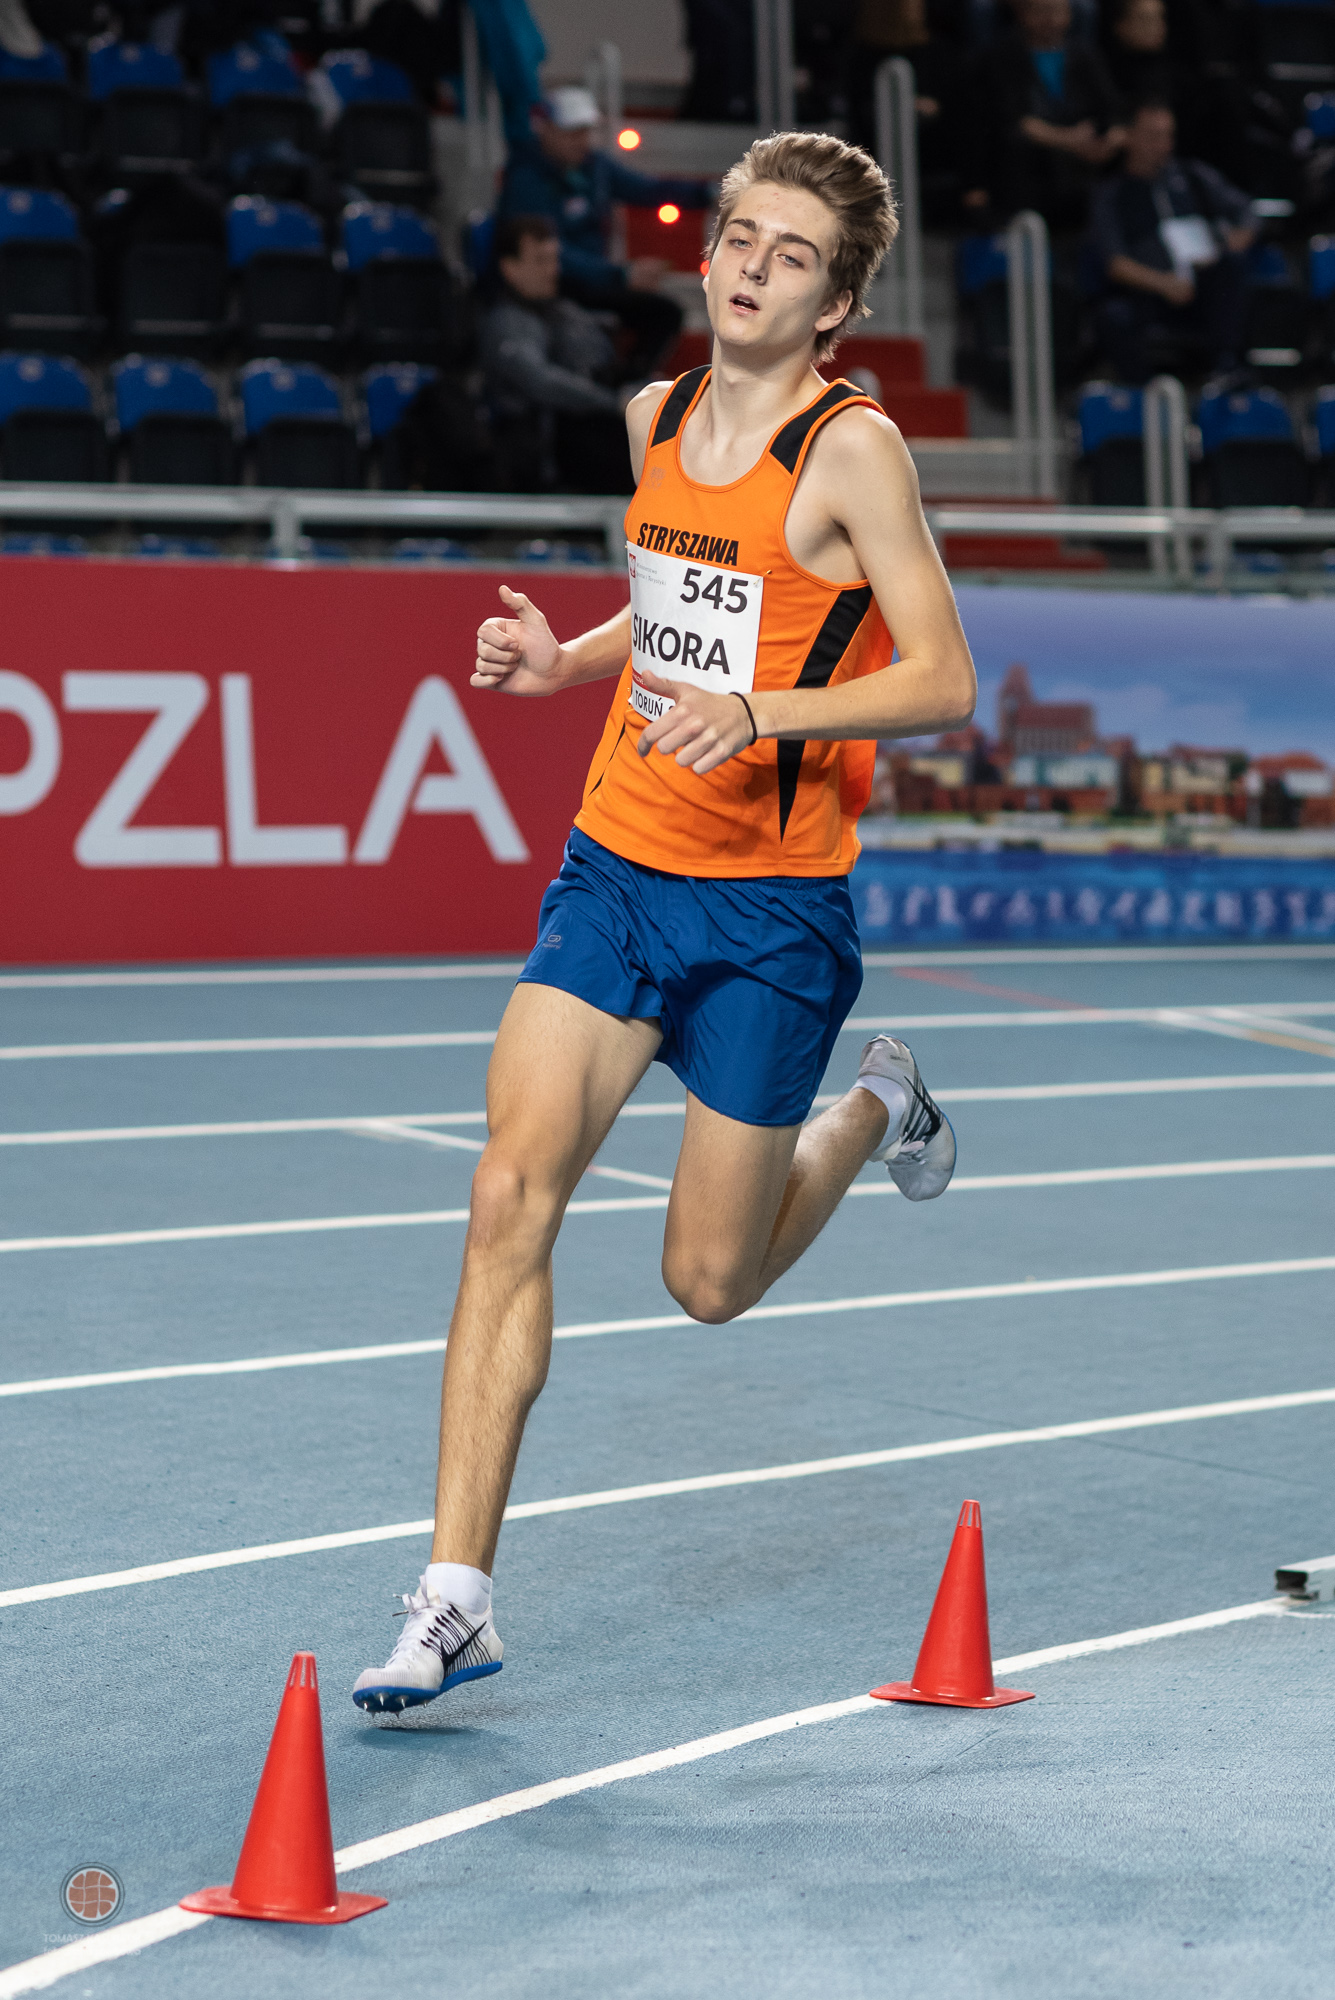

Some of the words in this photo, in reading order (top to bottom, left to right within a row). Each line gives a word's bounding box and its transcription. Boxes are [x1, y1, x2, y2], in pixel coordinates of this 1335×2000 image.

[637, 522, 740, 567] STRYSZAWA
[679, 567, 749, 614] 545
[632, 612, 731, 675] SIKORA
[635, 689, 664, 717] TORUŃ
